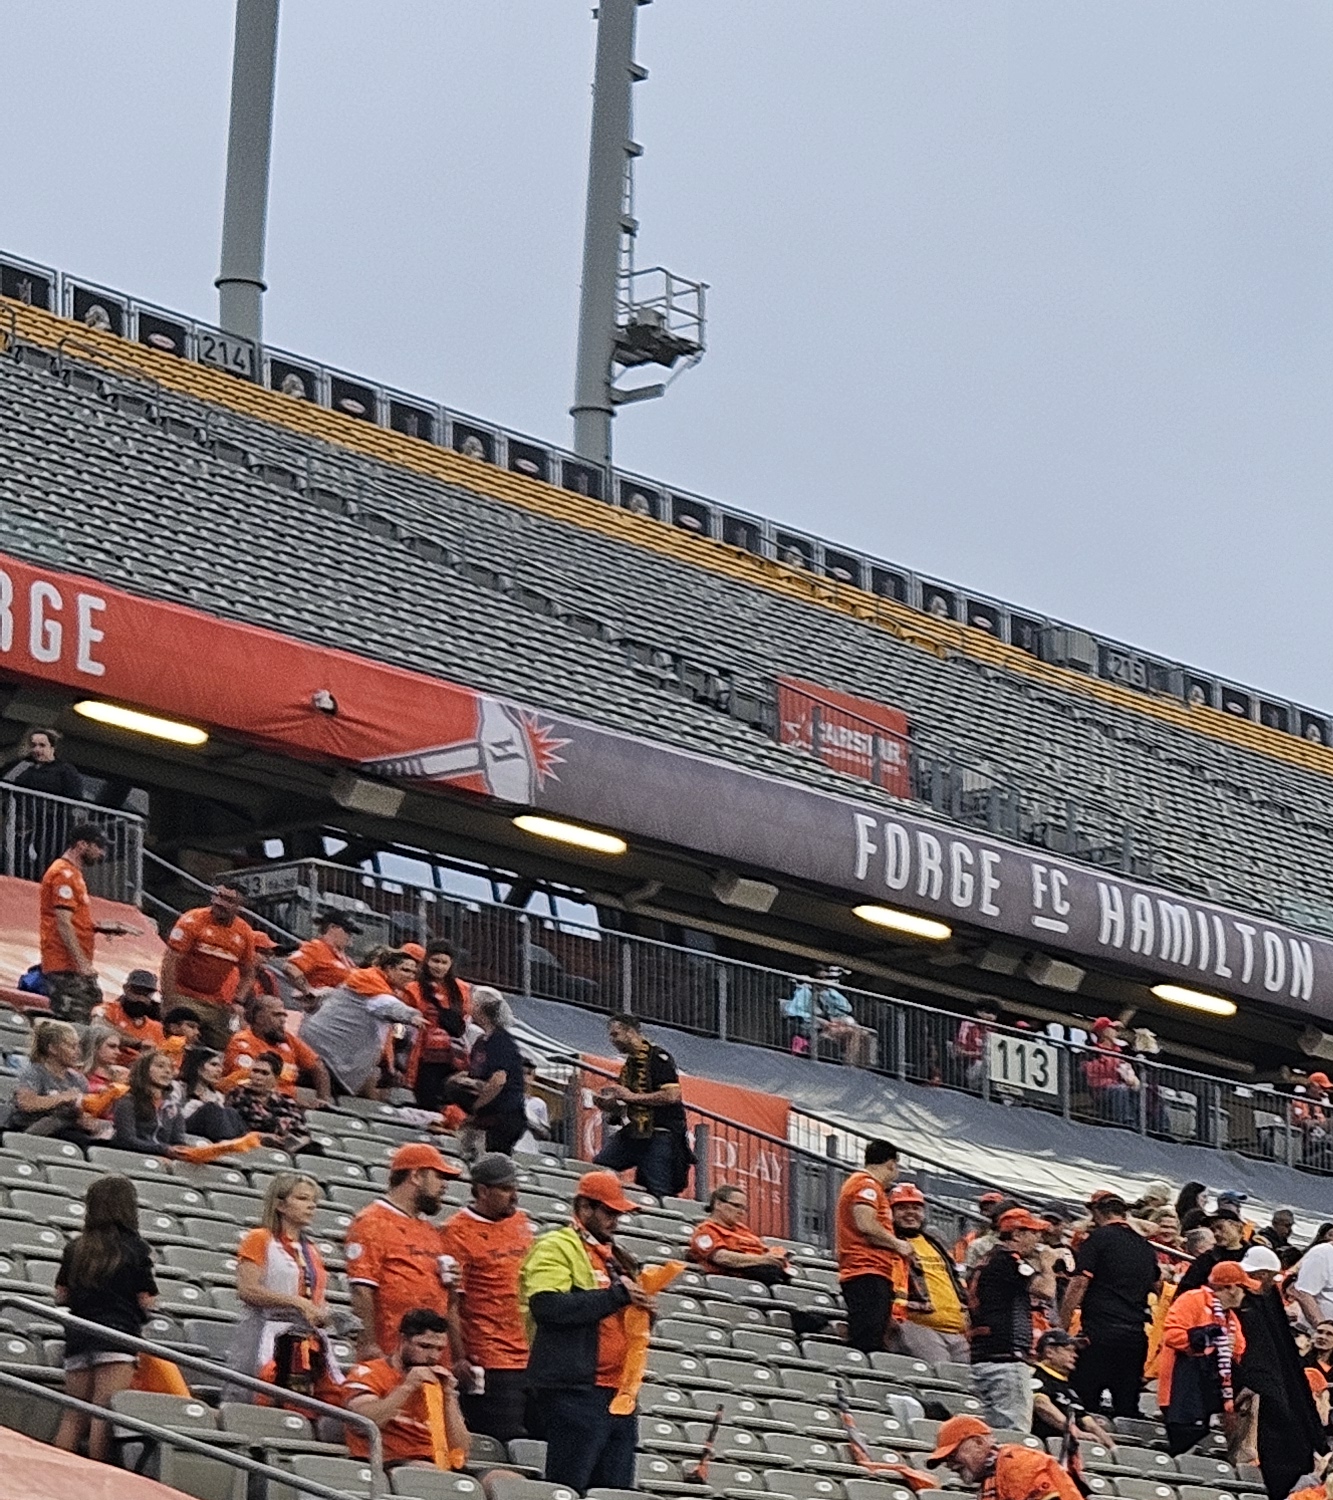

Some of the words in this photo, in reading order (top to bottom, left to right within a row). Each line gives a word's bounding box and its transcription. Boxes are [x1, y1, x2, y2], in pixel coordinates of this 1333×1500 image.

[203, 336, 246, 371] 214
[854, 813, 1001, 917] FORGE
[1032, 864, 1070, 916] FC
[1097, 882, 1314, 1001] HAMILTON
[998, 1039, 1049, 1088] 113
